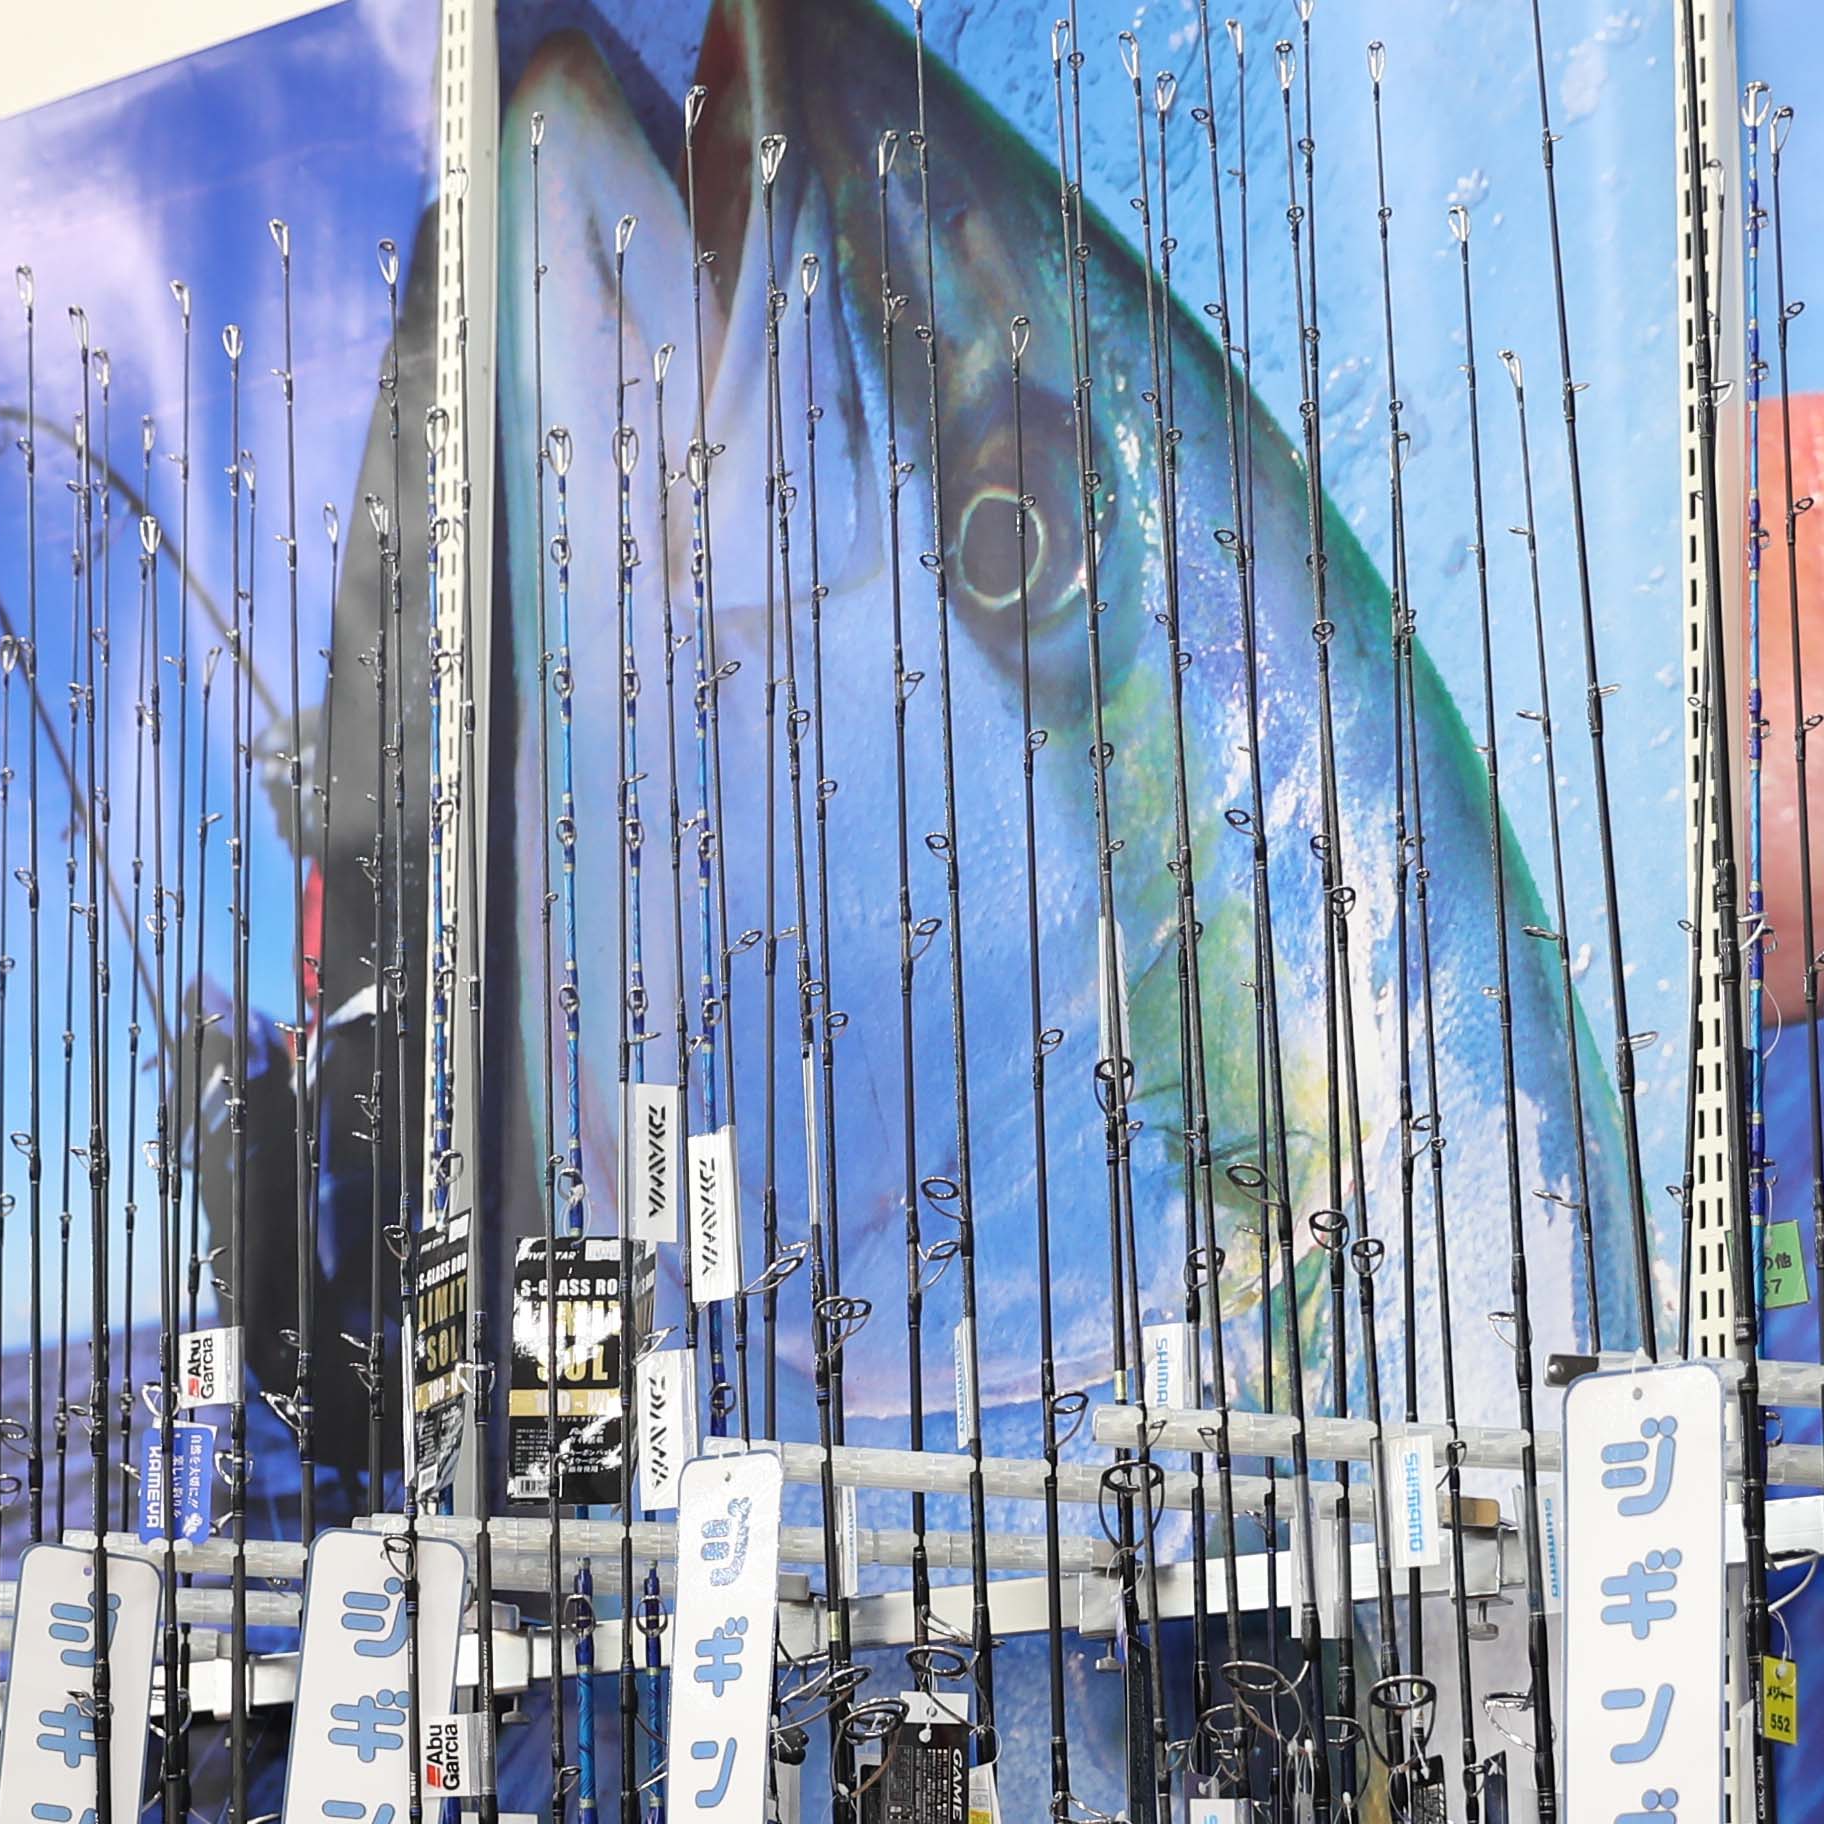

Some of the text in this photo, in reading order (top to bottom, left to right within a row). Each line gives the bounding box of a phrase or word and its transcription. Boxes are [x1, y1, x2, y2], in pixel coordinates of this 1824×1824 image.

[648, 1104, 667, 1218] DAIWA
[700, 1157, 720, 1277] DAIWA
[419, 1277, 466, 1332] LIMIT
[598, 1279, 618, 1296] RO
[188, 1338, 203, 1378] Abu
[200, 1333, 215, 1400] Garcia
[425, 1325, 459, 1374] SOL
[1156, 1337, 1170, 1408] SHIMA
[649, 1376, 670, 1490] DAIWA
[146, 1445, 163, 1529] KAMEYA
[1404, 1451, 1424, 1554] SHIMANO
[428, 1723, 444, 1764] Abu
[442, 1719, 461, 1792] Garcia
[1770, 1713, 1791, 1734] 552
[951, 1746, 964, 1822] GAME
